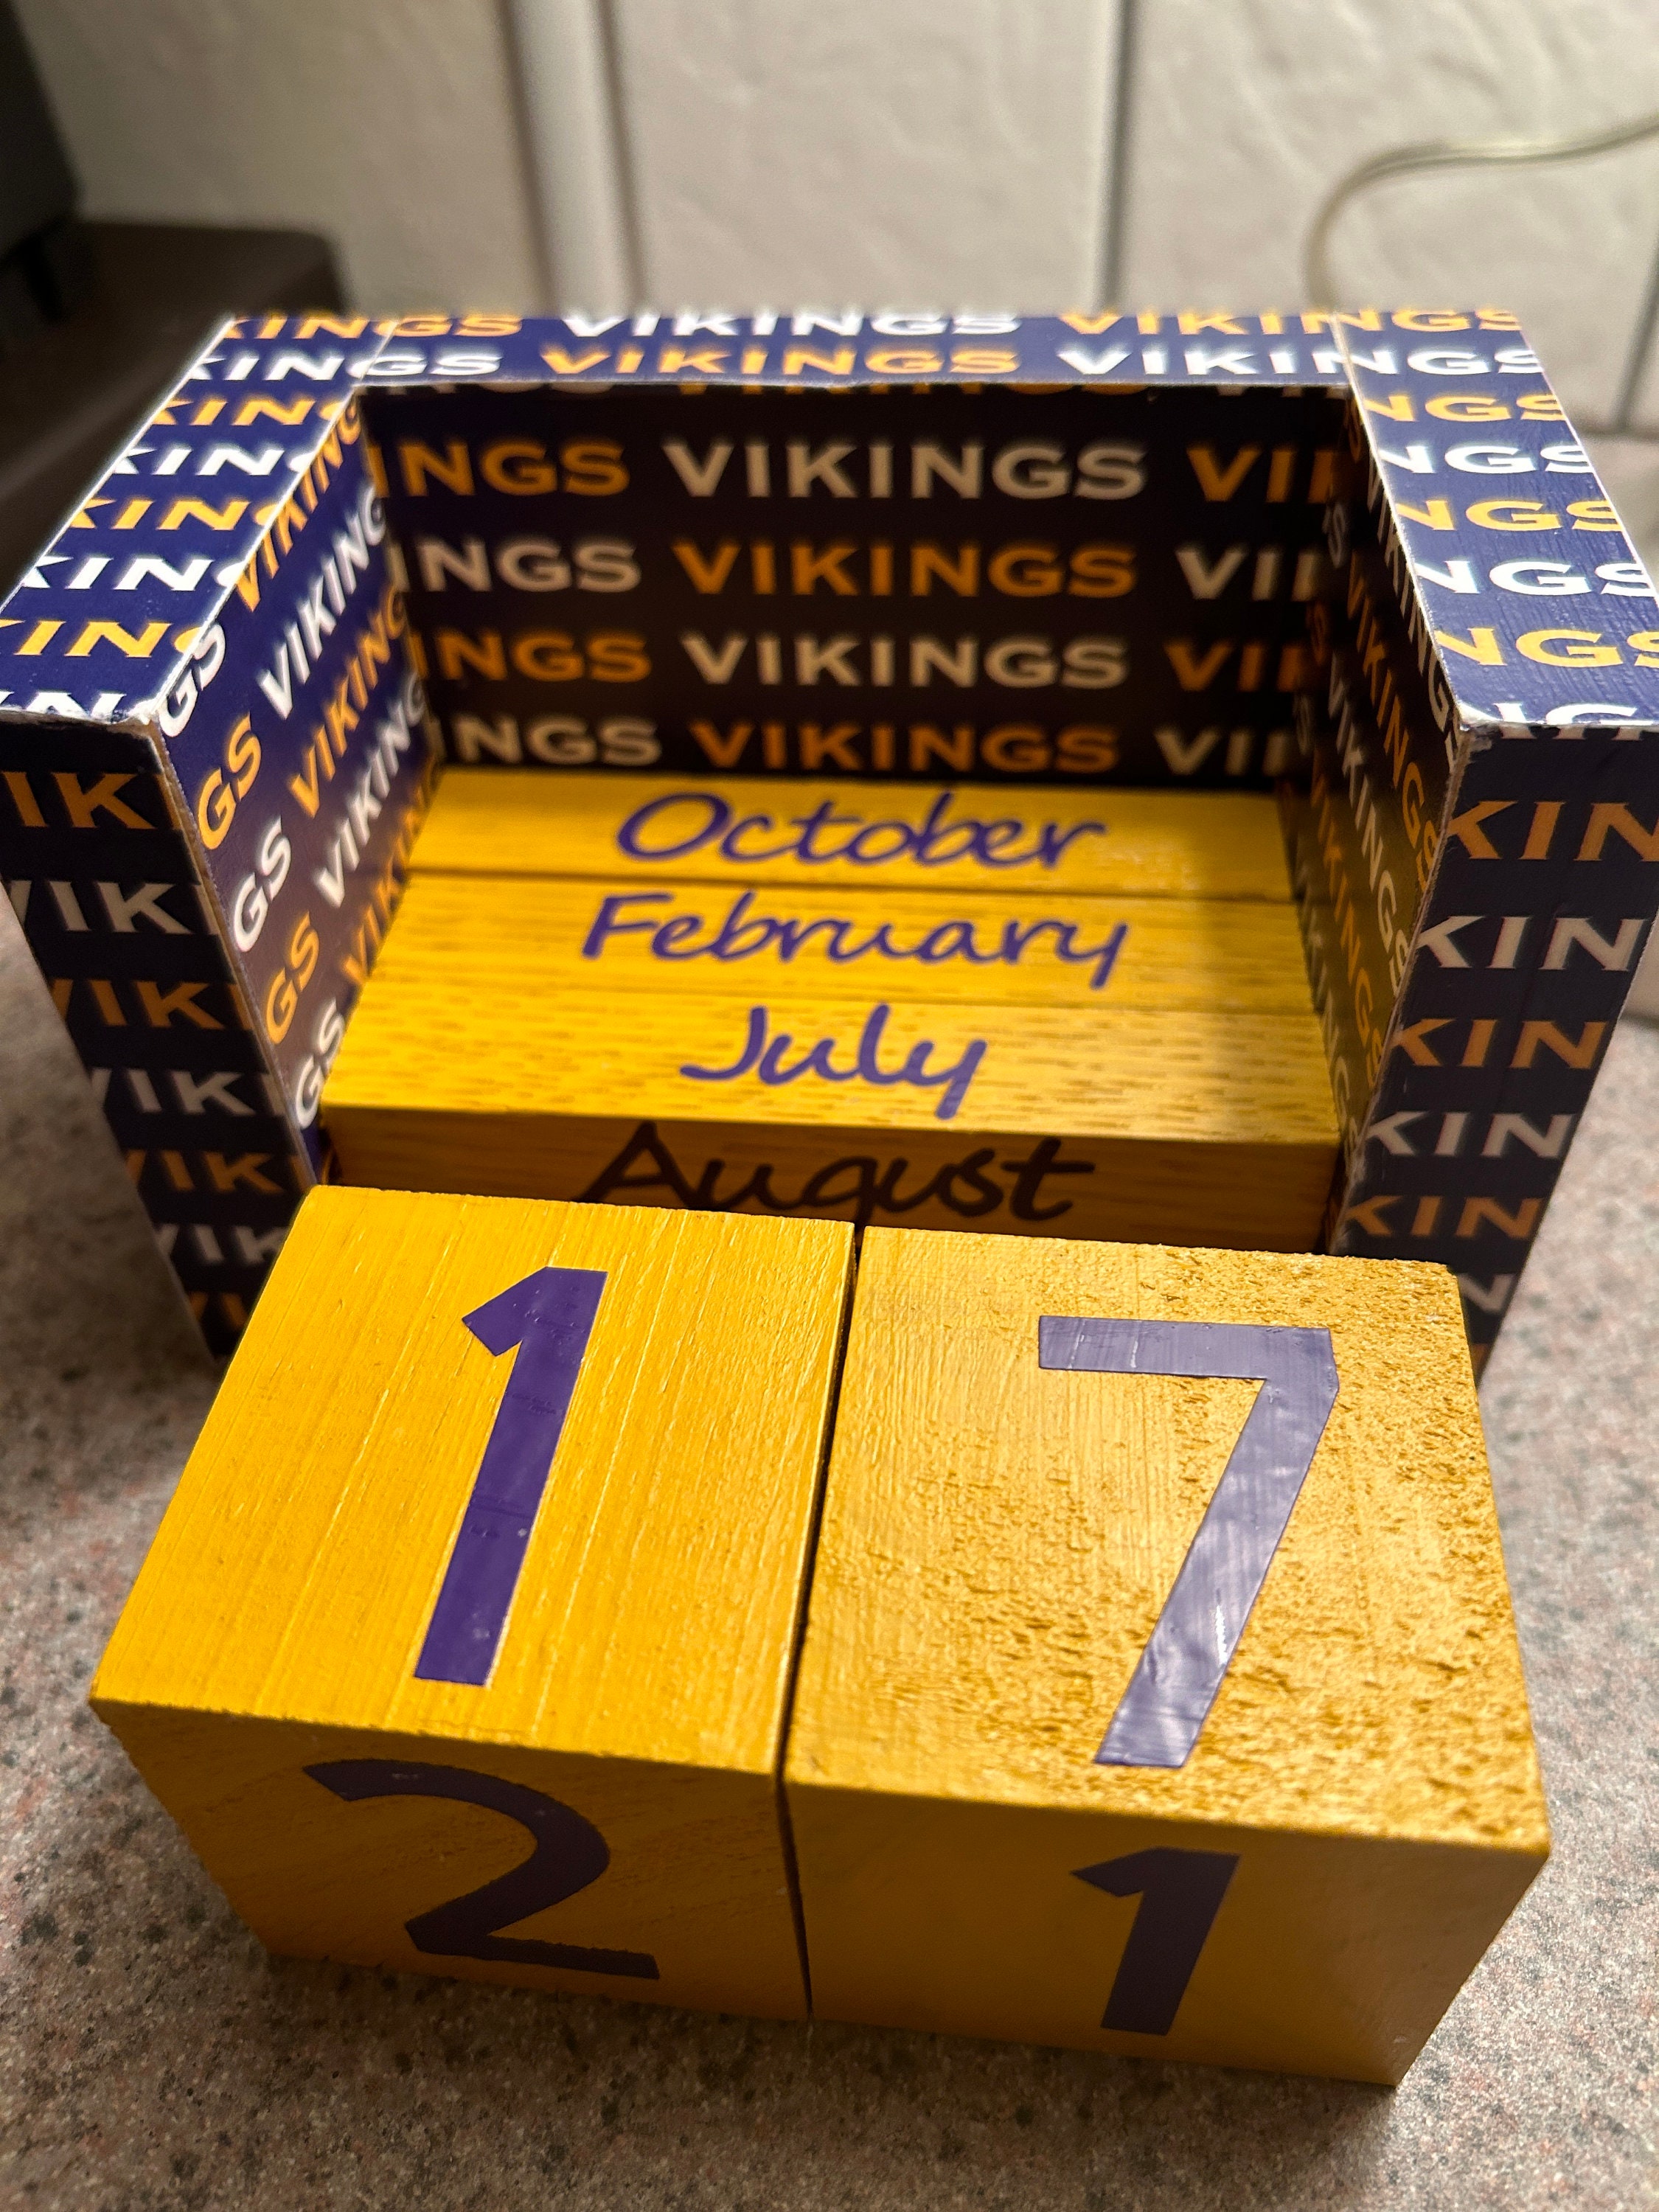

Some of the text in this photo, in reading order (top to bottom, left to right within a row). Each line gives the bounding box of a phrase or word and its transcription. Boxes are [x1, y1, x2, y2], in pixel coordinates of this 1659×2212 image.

[541, 348, 1021, 375] VIKINGS
[1056, 347, 1544, 375] VIKINGS
[563, 313, 1021, 337] VIKINGS
[664, 441, 1148, 500] VIKINGS
[672, 540, 1137, 598] VIKINGS
[681, 633, 1129, 689] VIKINGS
[198, 712, 262, 850] GS
[689, 720, 1119, 773] VIKINGS
[617, 790, 1107, 870] October
[232, 815, 292, 953] GS
[266, 911, 319, 1045] GS
[582, 890, 1129, 990] February
[679, 1004, 987, 1119] July
[573, 1121, 1096, 1224] August
[414, 1267, 608, 1686] 1
[1039, 1315, 1339, 1768] 7
[302, 1759, 660, 1979] 2
[1070, 1846, 1239, 2036] 1
